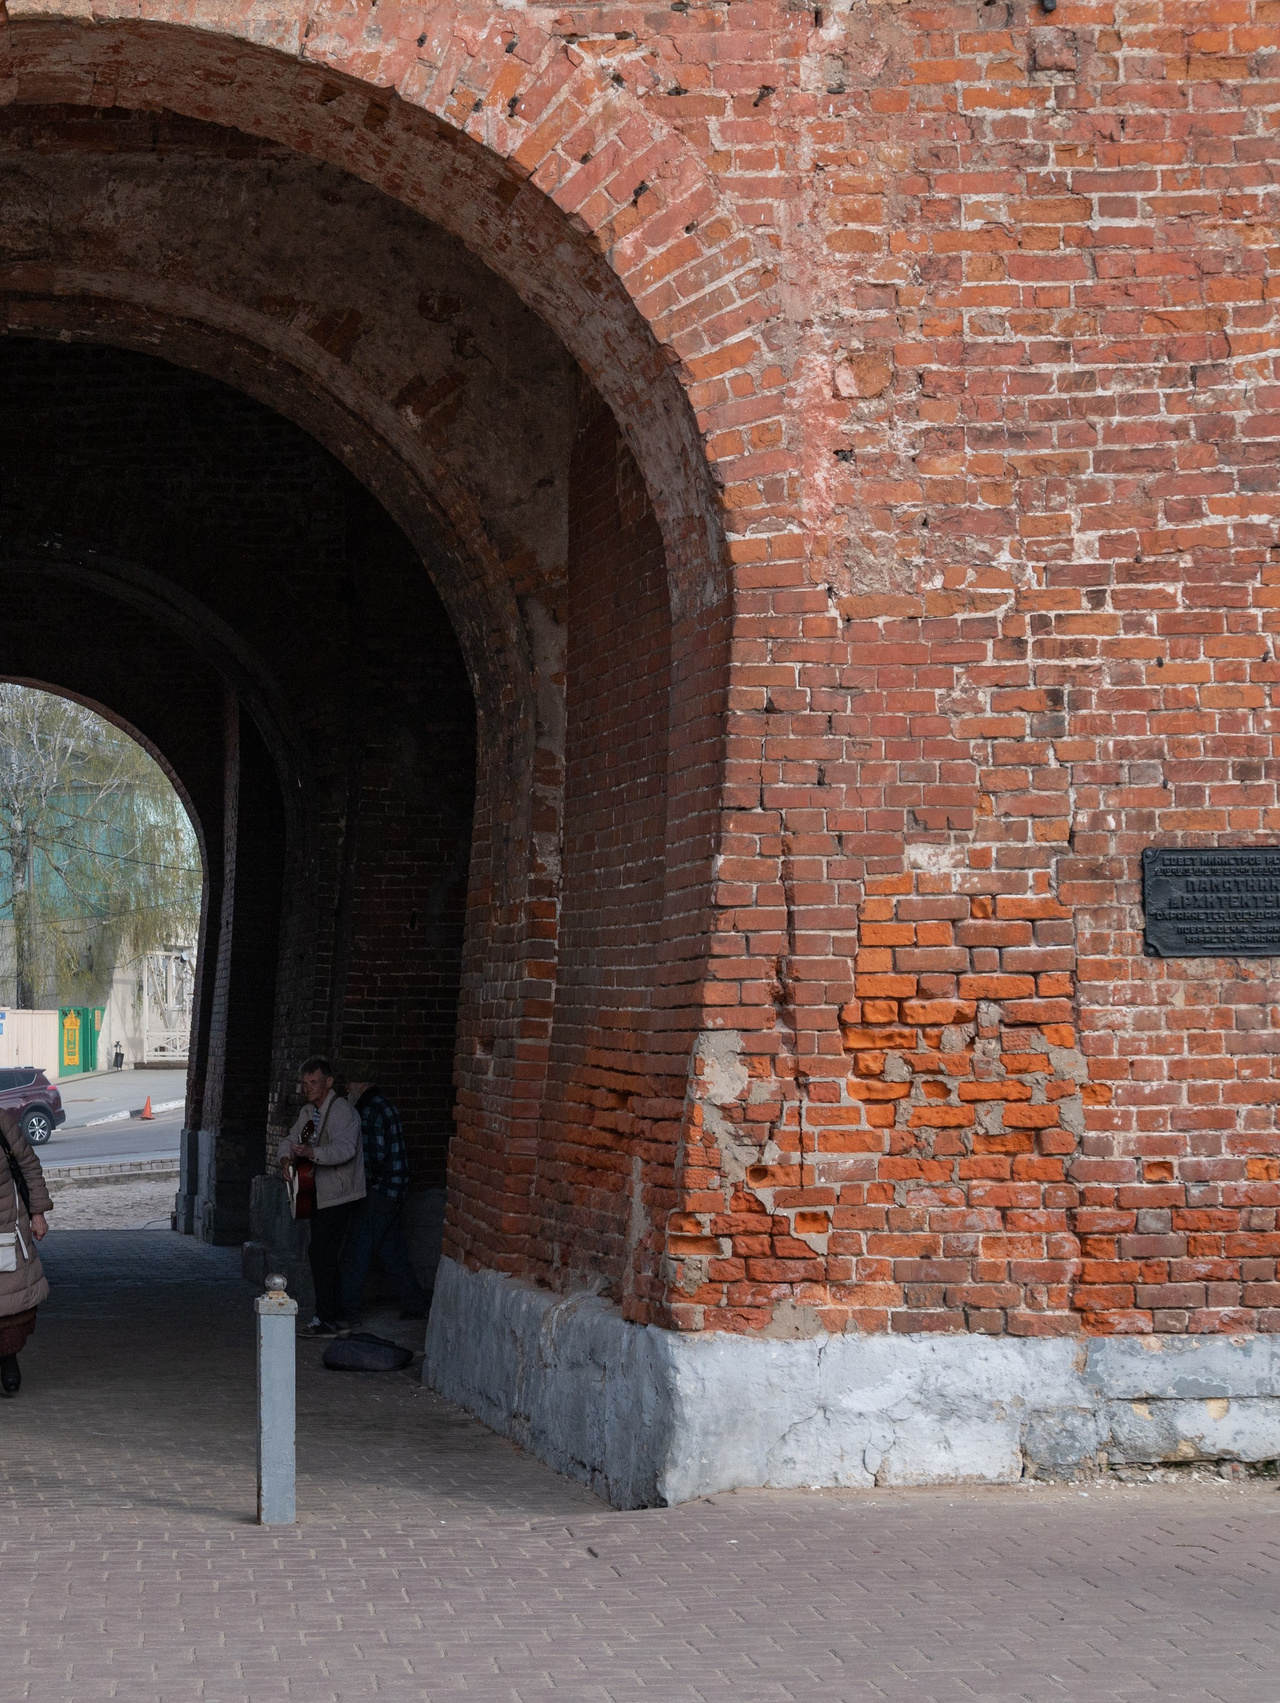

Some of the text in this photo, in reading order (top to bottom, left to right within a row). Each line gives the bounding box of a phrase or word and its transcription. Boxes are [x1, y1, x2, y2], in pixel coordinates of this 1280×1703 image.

[1162, 856, 1197, 867] СОВЕТ
[1200, 856, 1262, 867] МИНИСТРОВ
[1185, 877, 1280, 893] ПАМЯТНИК
[1155, 909, 1226, 921] ОХРАНЯЕТСЯ
[1176, 924, 1249, 935] ПОВРЕЖДЕНИЕ
[1186, 934, 1236, 943] КАРАЕТСЯ
